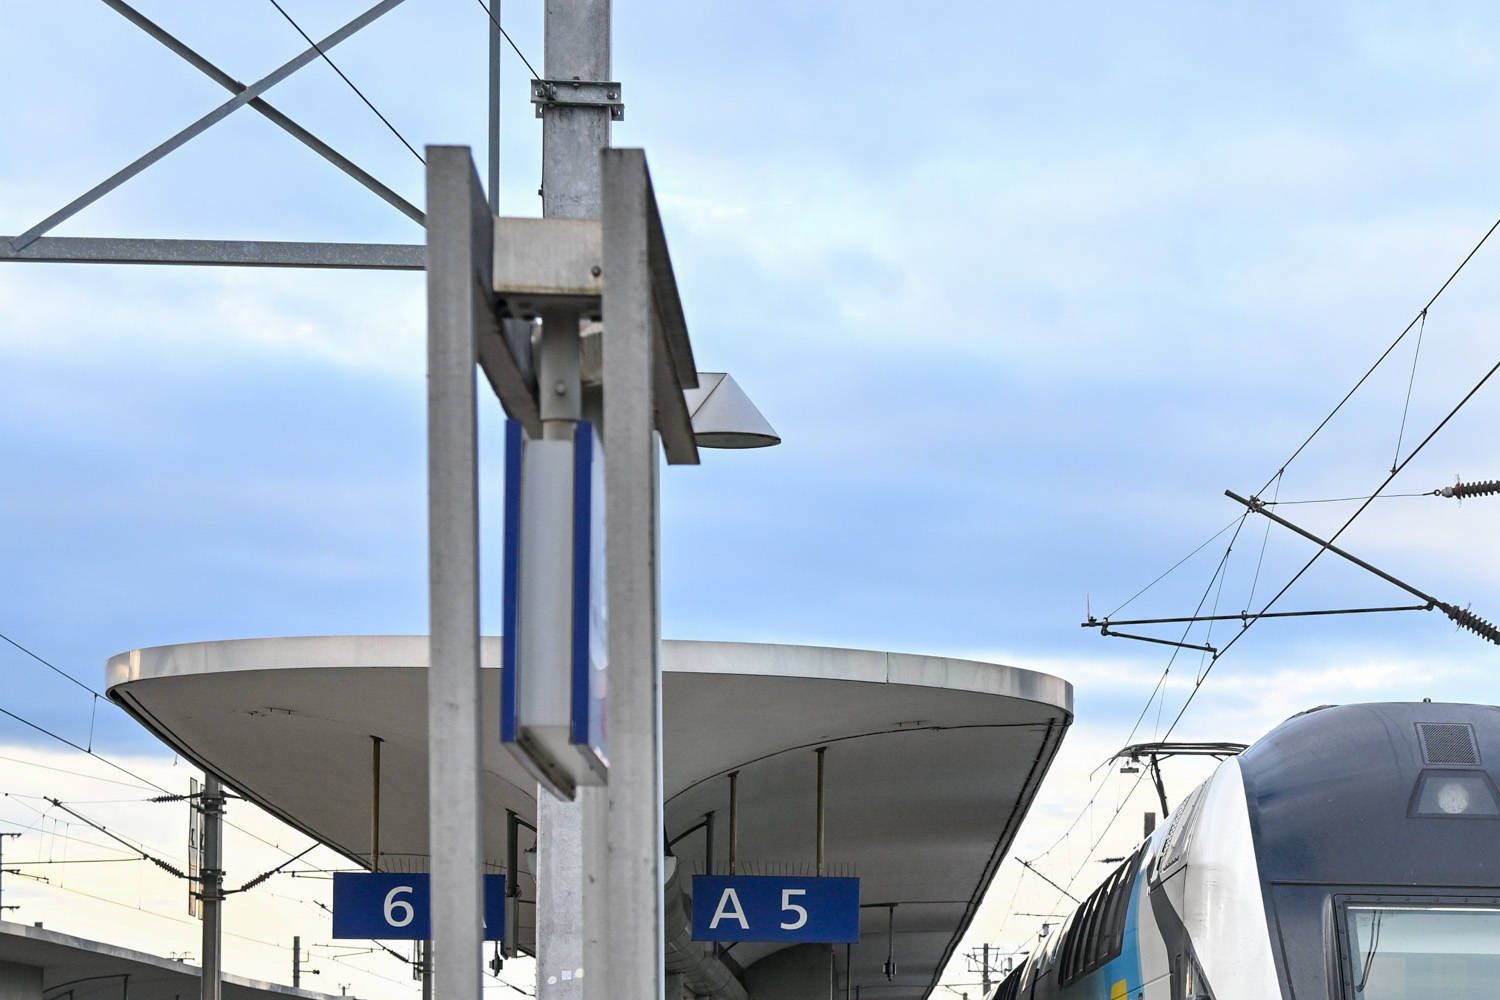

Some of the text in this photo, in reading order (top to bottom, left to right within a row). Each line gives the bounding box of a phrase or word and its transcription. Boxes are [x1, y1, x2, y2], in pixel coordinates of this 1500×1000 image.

[383, 886, 415, 928] 6
[708, 887, 808, 931] A 5
